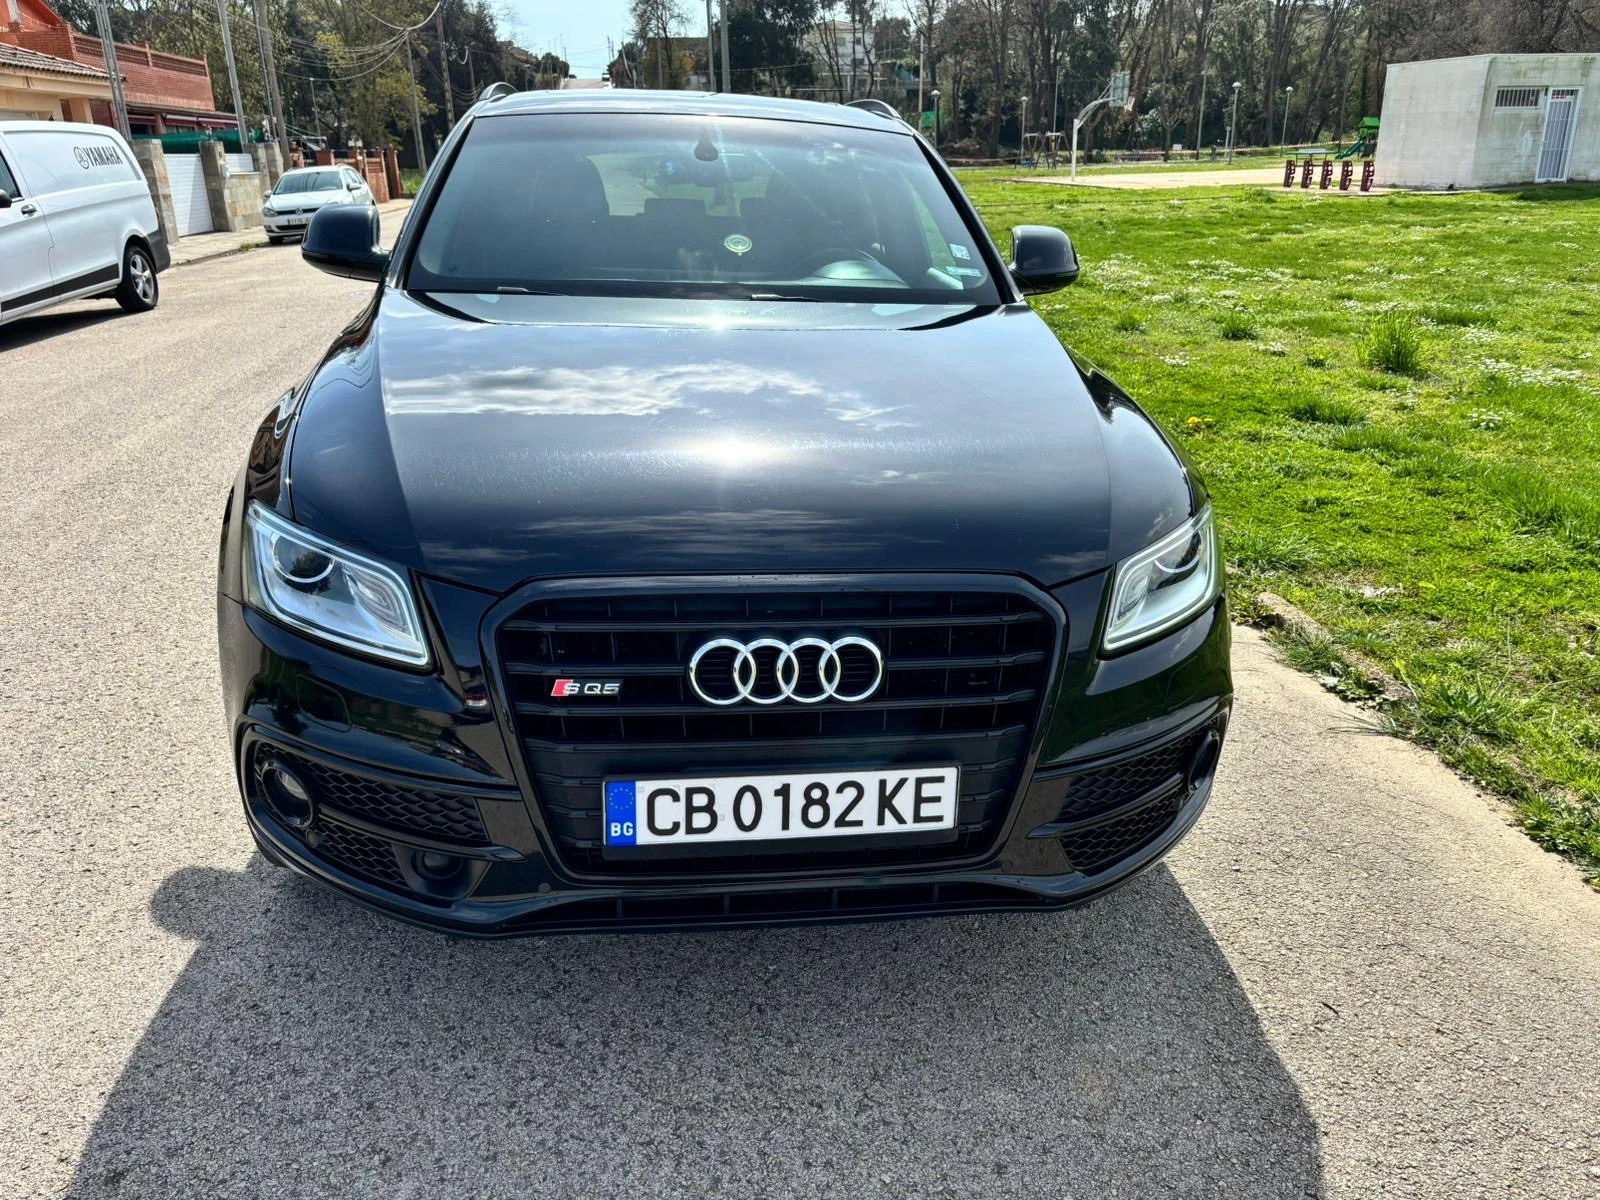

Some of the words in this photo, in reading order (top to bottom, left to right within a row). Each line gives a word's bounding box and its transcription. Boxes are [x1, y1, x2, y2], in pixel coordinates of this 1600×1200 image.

[82, 146, 123, 166] YAMAHA
[646, 786, 718, 836] CB
[732, 780, 865, 832] 0182
[877, 775, 946, 826] KE
[610, 821, 634, 837] BG
